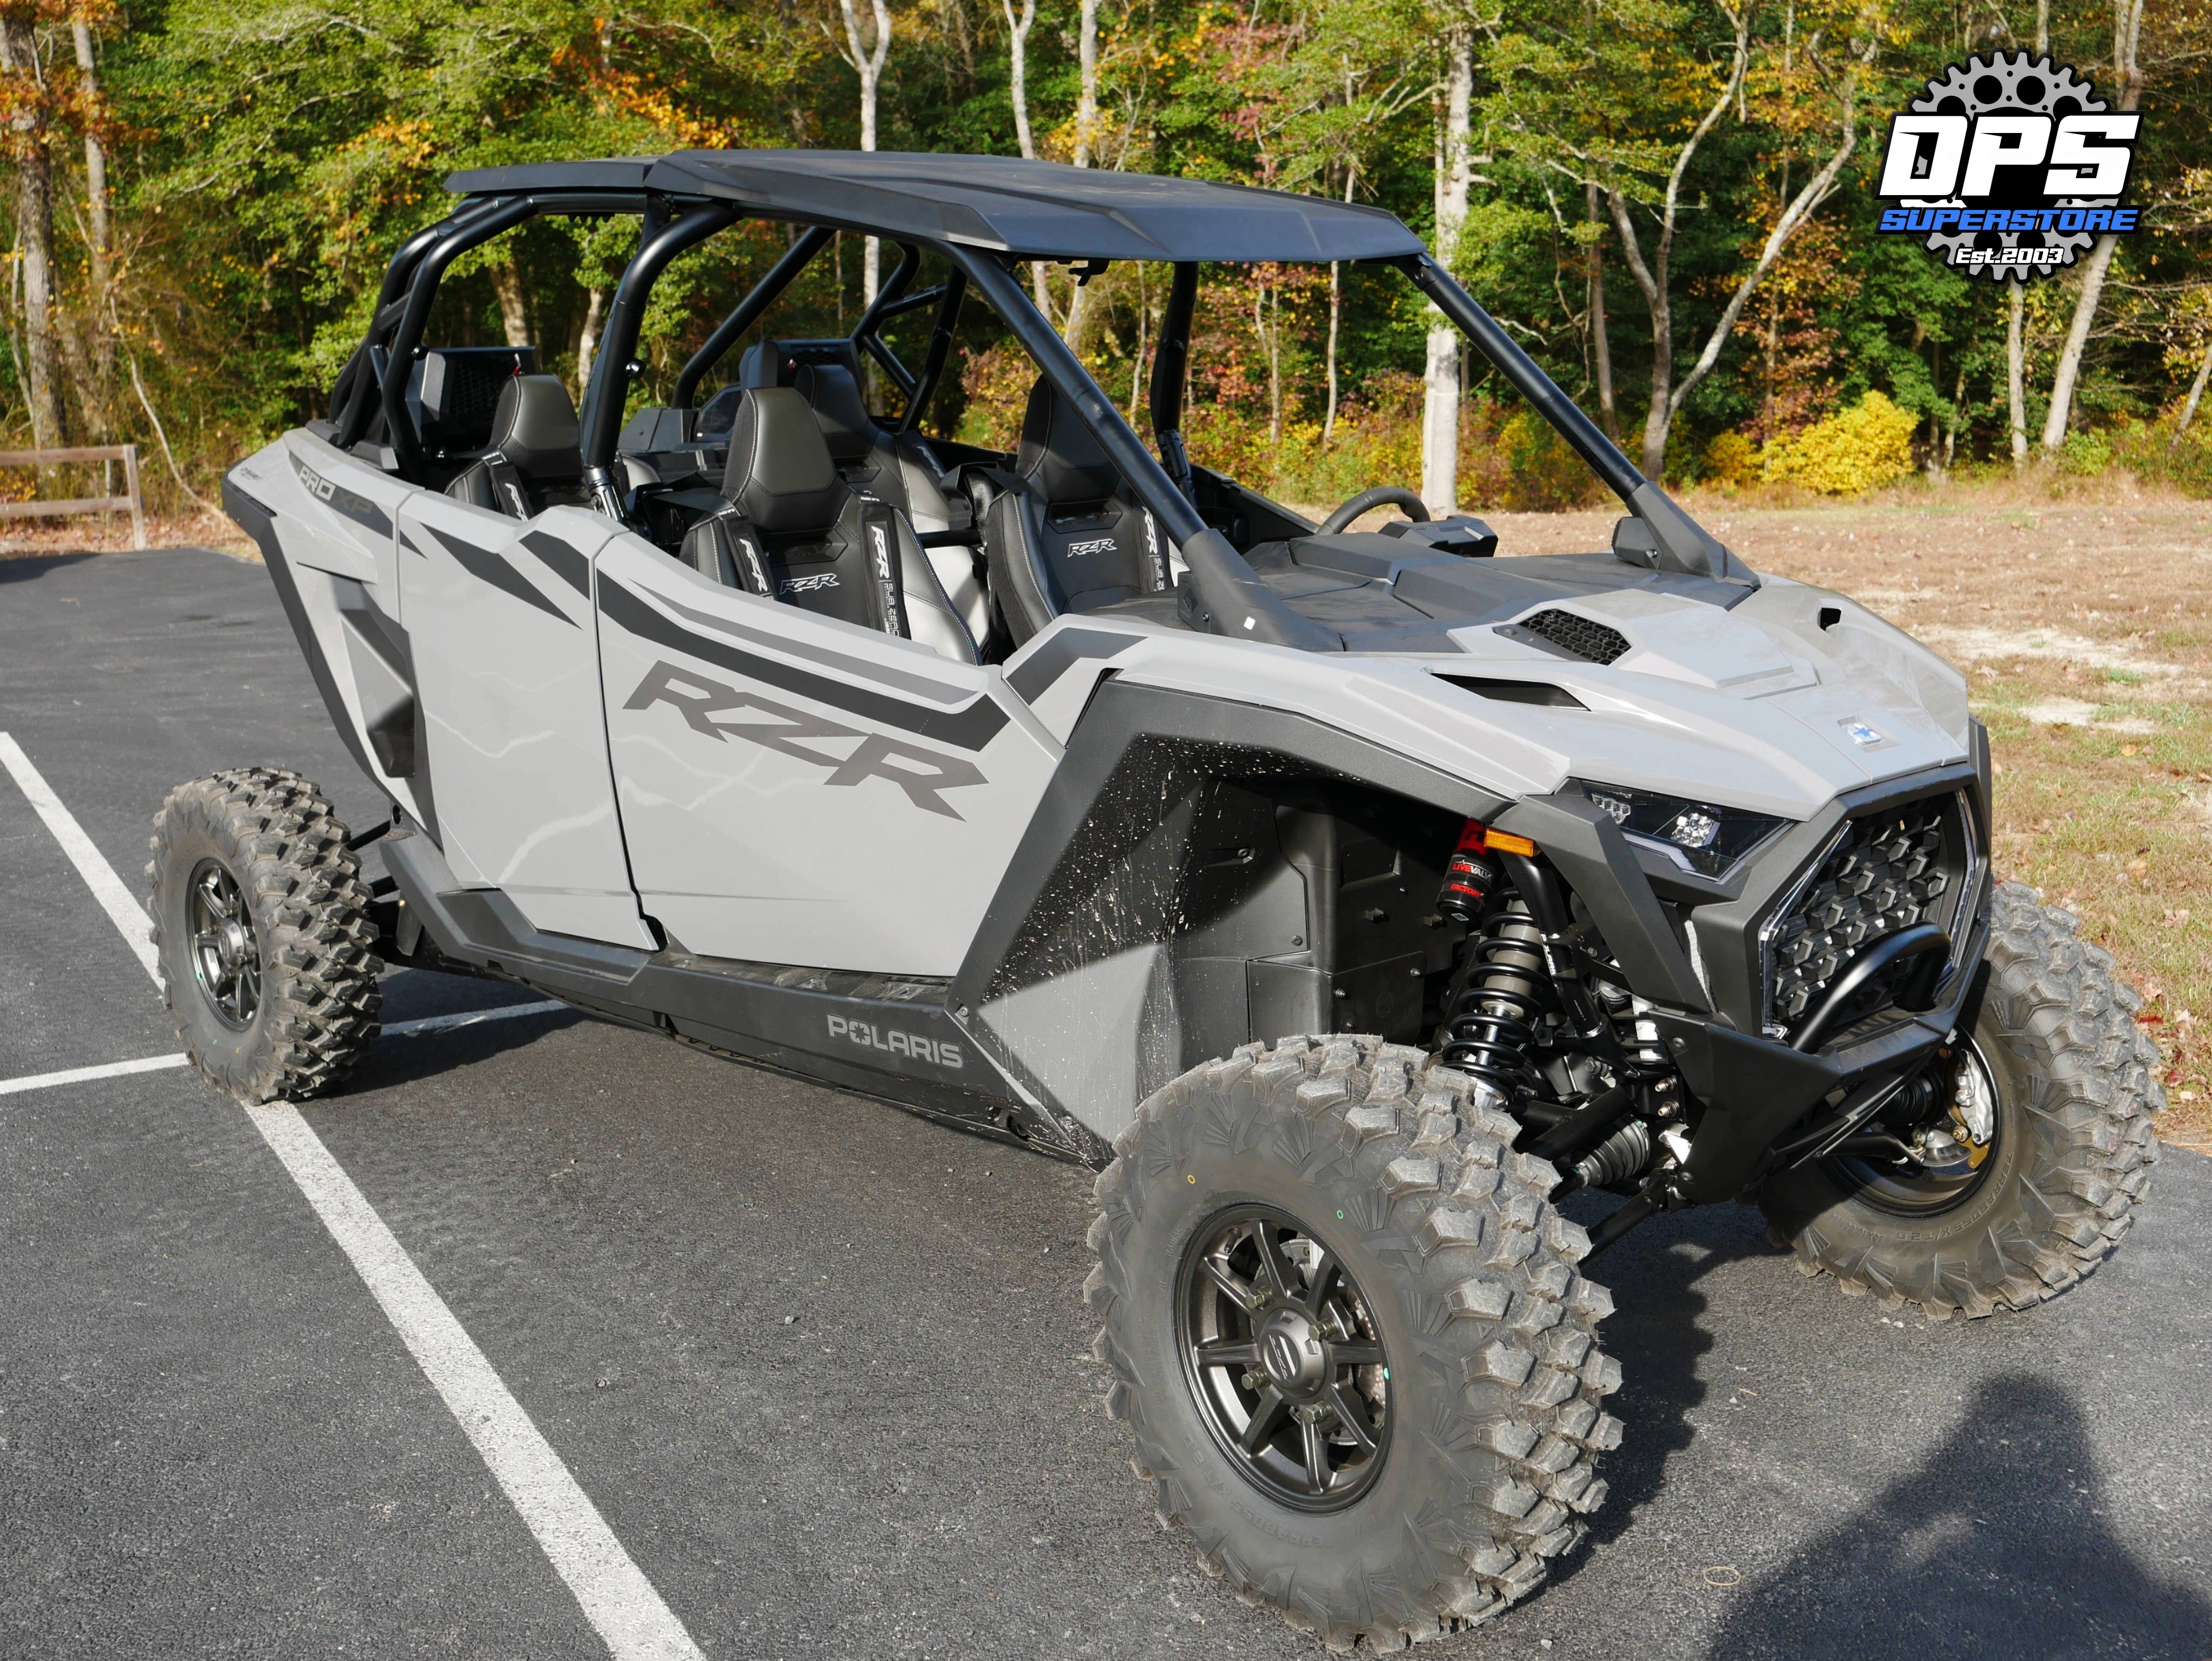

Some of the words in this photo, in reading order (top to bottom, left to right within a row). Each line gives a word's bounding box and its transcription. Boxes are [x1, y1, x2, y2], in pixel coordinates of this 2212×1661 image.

[299, 465, 336, 501] PRO
[338, 490, 373, 514] XP
[739, 539, 768, 592] RZR
[871, 526, 889, 579] RZR
[886, 583, 895, 606] SUB
[1067, 539, 1118, 557] RZR
[779, 573, 840, 595] RZR
[622, 659, 990, 823] RZR
[1450, 883, 1481, 898] FACTORY
[828, 1015, 962, 1068] POLARIS
